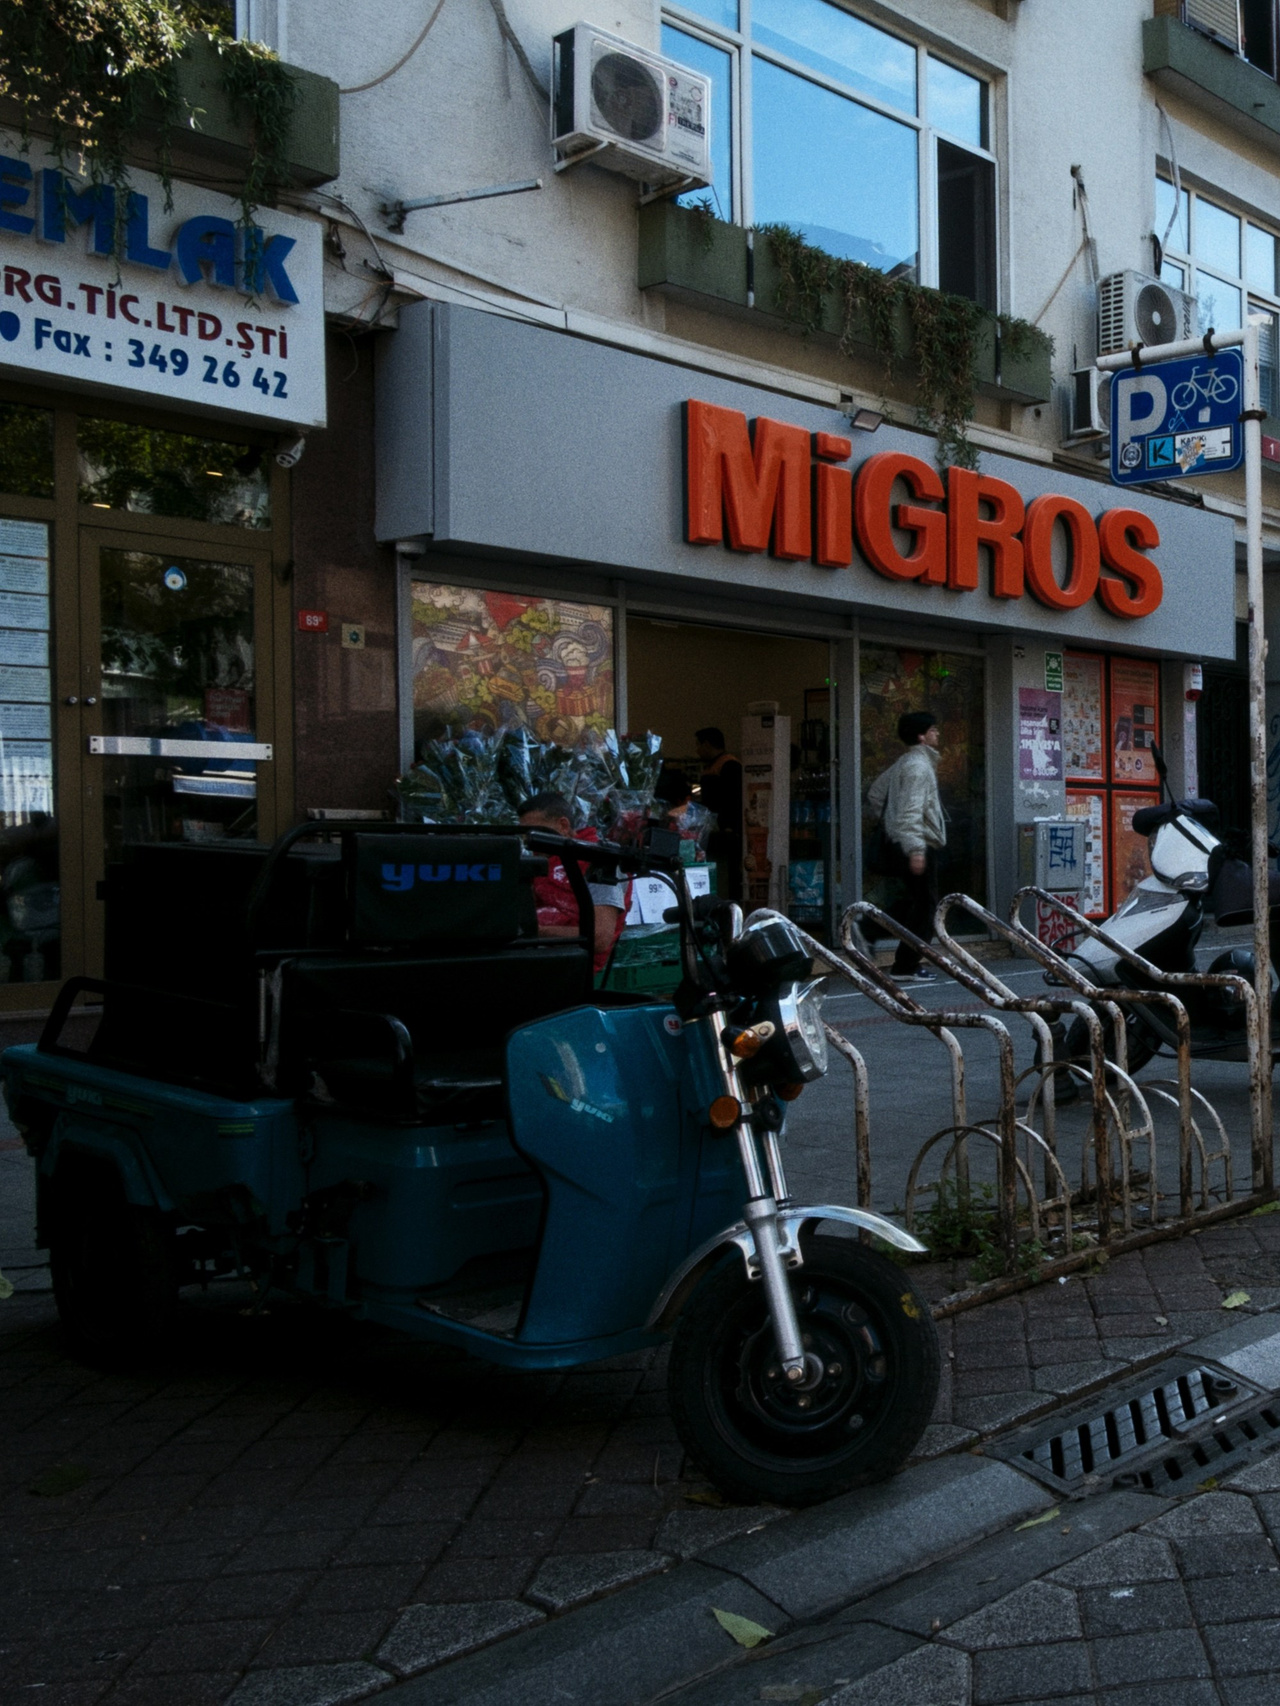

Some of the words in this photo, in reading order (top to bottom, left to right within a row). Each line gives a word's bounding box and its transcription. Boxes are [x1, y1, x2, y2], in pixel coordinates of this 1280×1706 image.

[35, 318, 91, 357] Fax
[128, 338, 189, 376] 349
[203, 355, 240, 388] 26
[253, 371, 288, 399] 42
